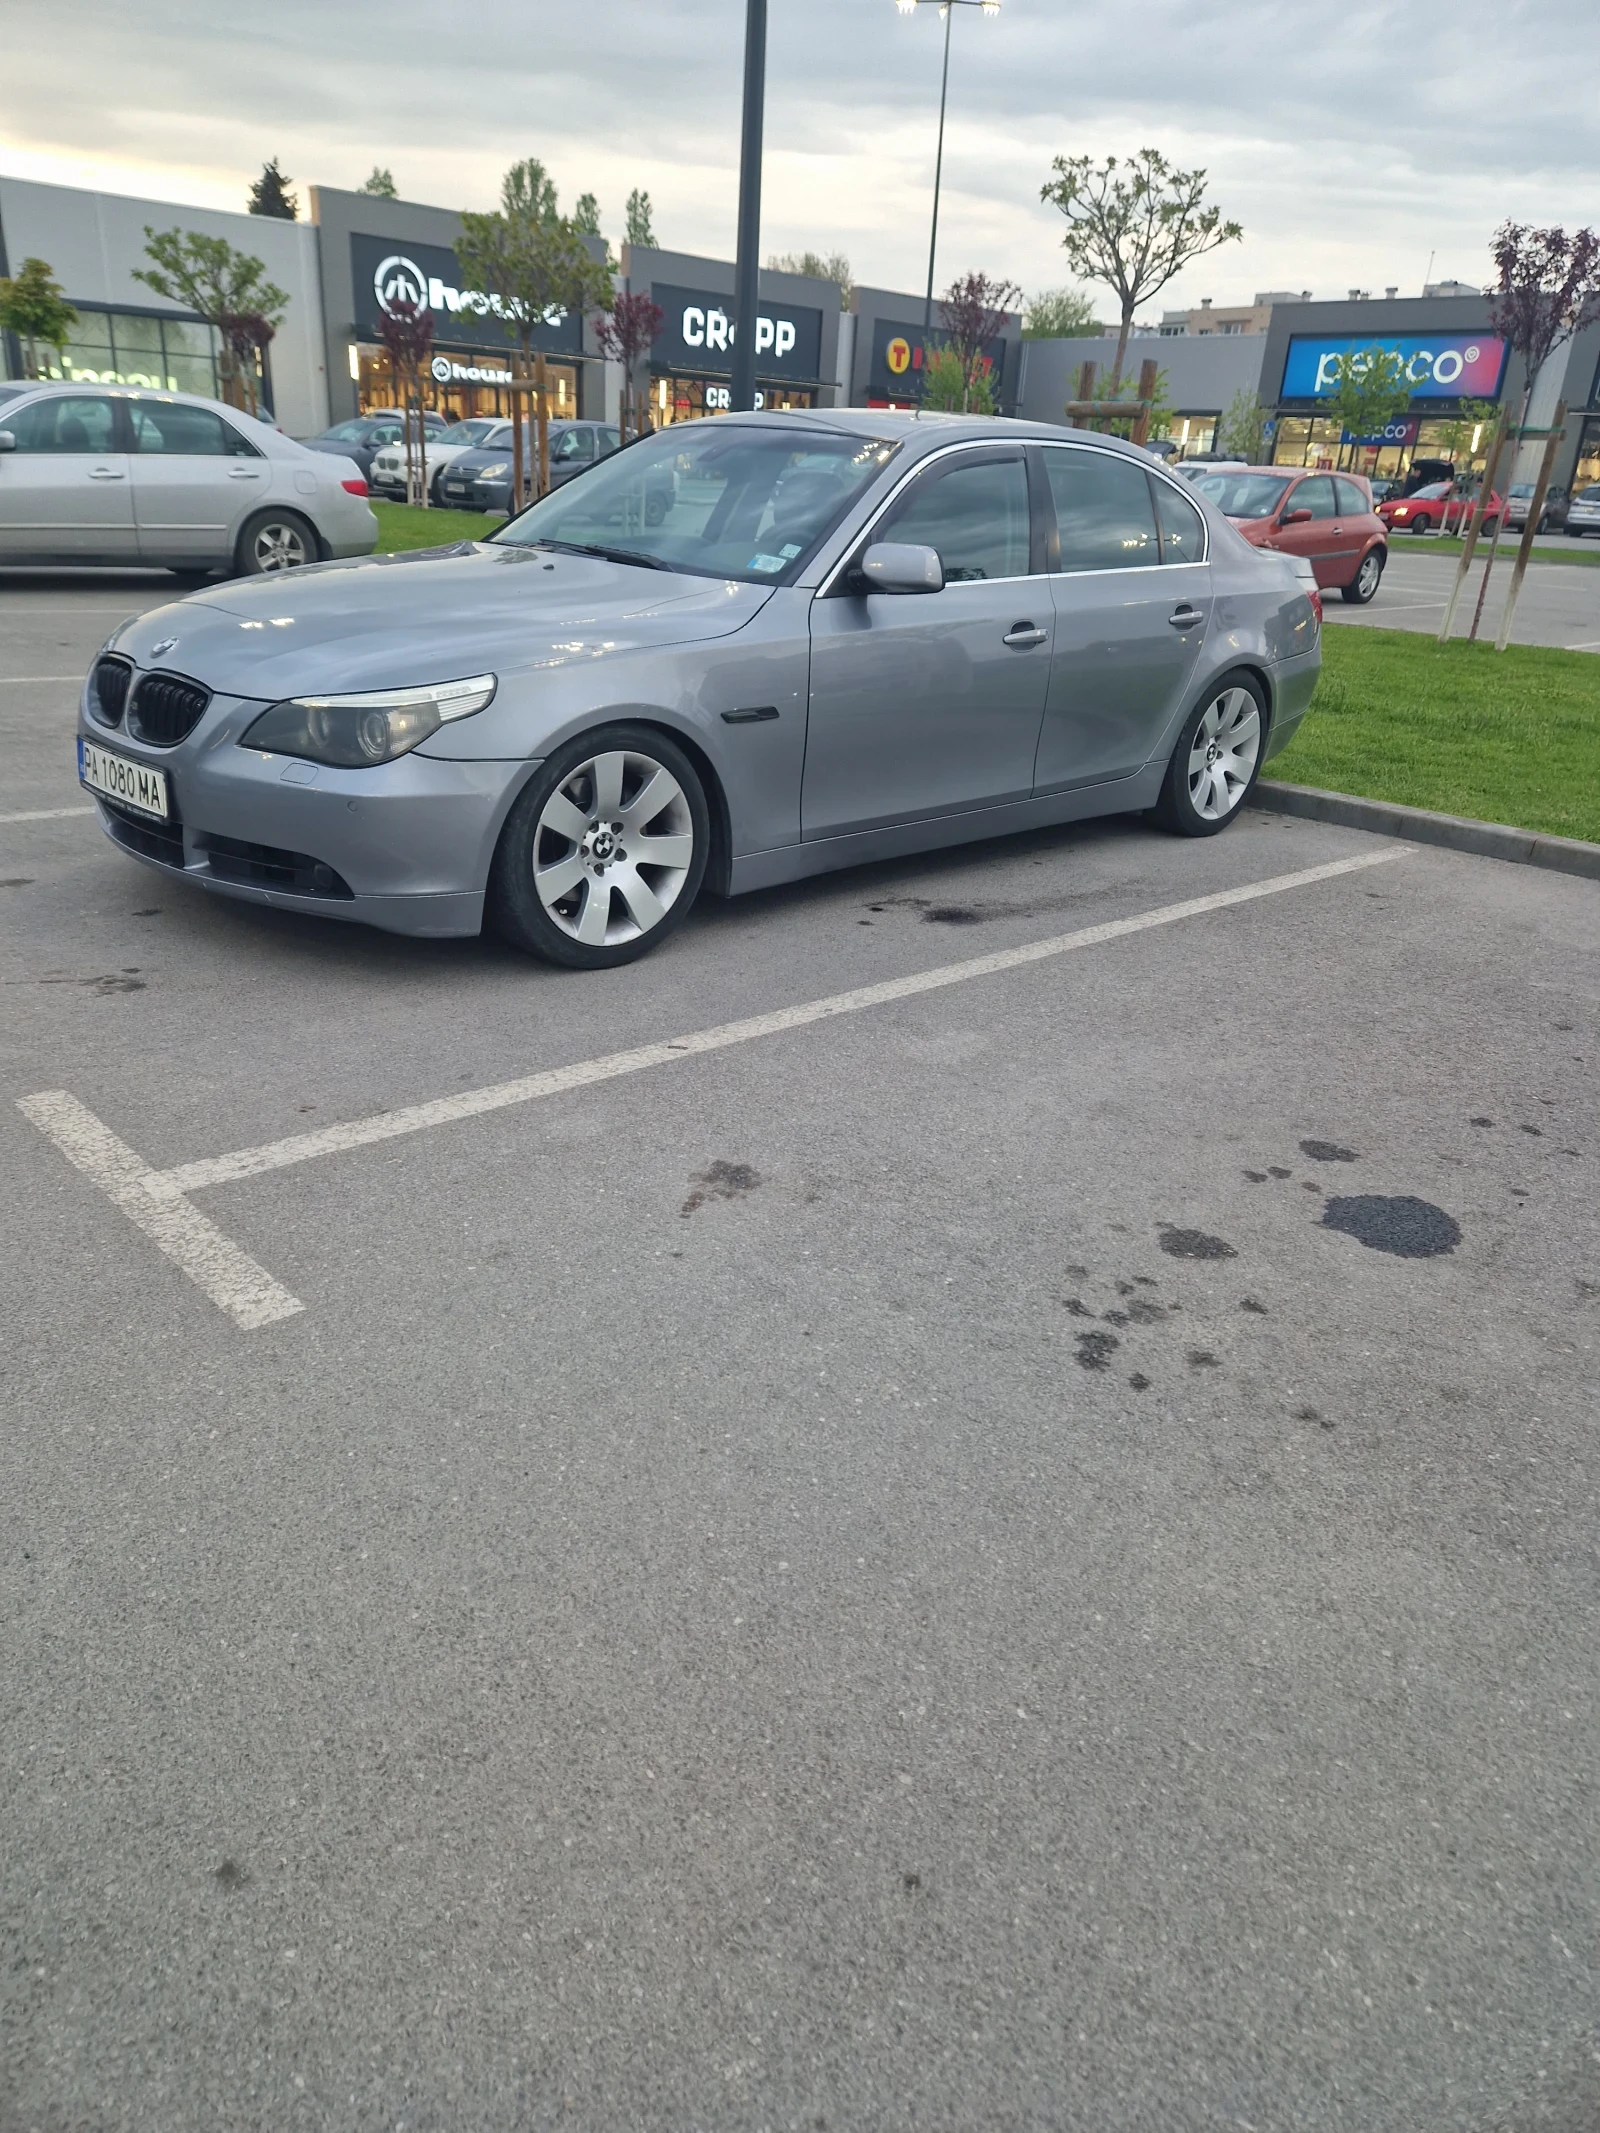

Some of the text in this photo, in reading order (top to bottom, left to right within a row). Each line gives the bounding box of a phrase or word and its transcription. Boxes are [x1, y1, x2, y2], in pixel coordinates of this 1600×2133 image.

[682, 306, 797, 358] CRPP
[705, 386, 765, 411] CRP
[84, 747, 161, 810] PA 1080 MA
